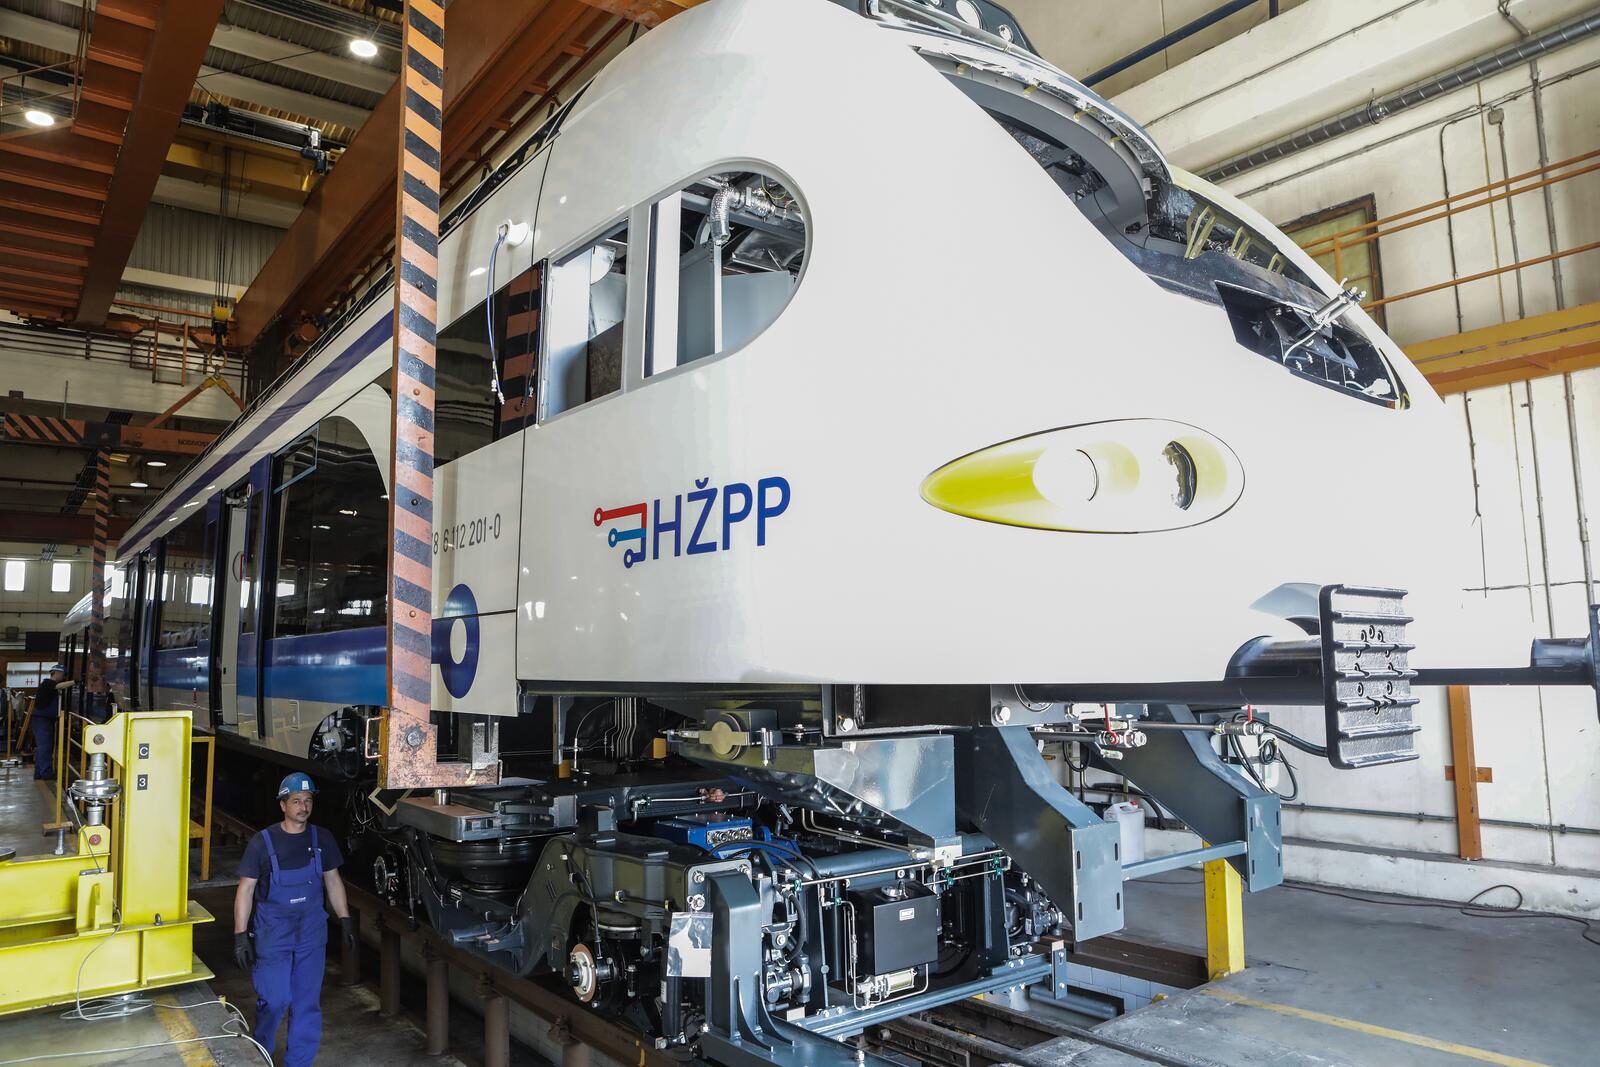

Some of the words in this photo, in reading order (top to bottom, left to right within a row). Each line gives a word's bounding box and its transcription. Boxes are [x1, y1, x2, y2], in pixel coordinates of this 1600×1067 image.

[652, 476, 791, 561] HŽPP
[431, 531, 439, 555] 8
[468, 512, 501, 546] 201-0
[139, 746, 149, 756] C
[138, 777, 146, 787] 3
